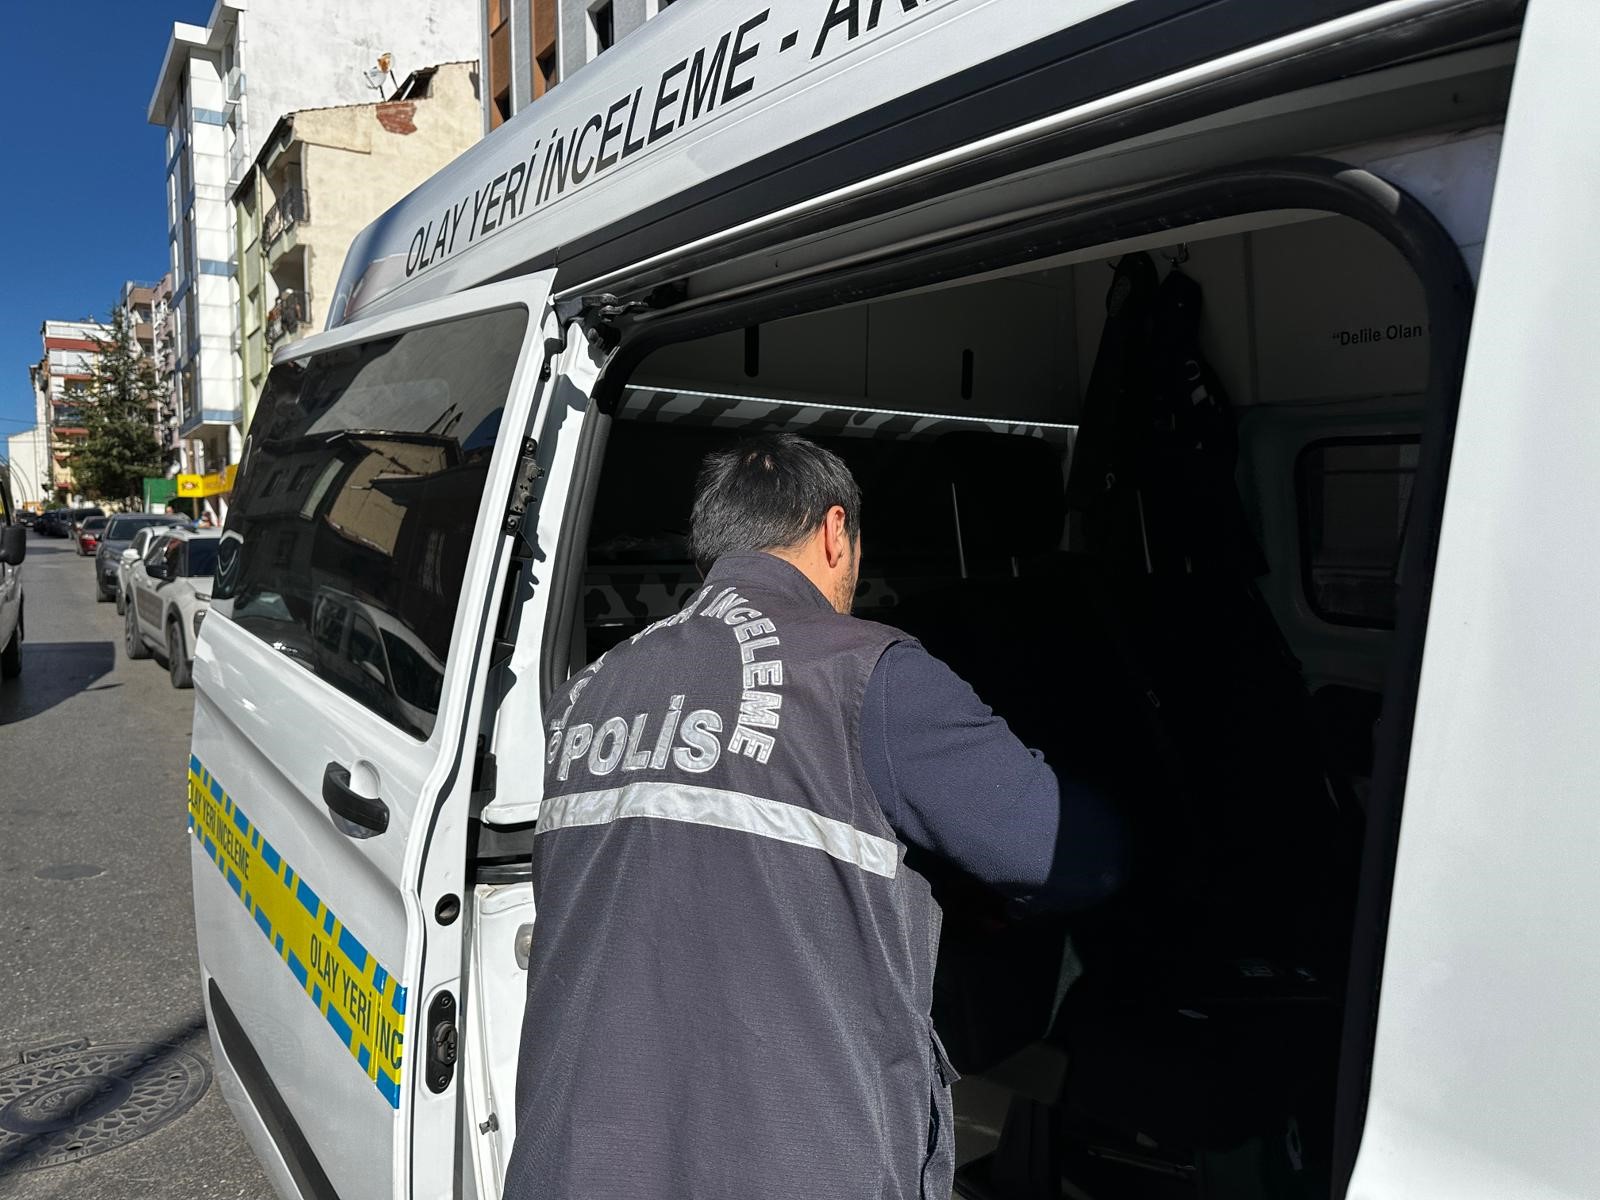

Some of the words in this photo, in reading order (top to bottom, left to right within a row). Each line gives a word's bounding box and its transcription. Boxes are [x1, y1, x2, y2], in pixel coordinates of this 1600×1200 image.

[405, 196, 470, 278] OLAY
[469, 139, 541, 243] YERİ
[534, 7, 771, 207] İNCELEME
[1386, 324, 1422, 340] Olan
[556, 694, 723, 781] POLİS
[215, 808, 249, 880] İNCELEME
[310, 933, 339, 993] OLAY
[342, 968, 373, 1036] YERİ
